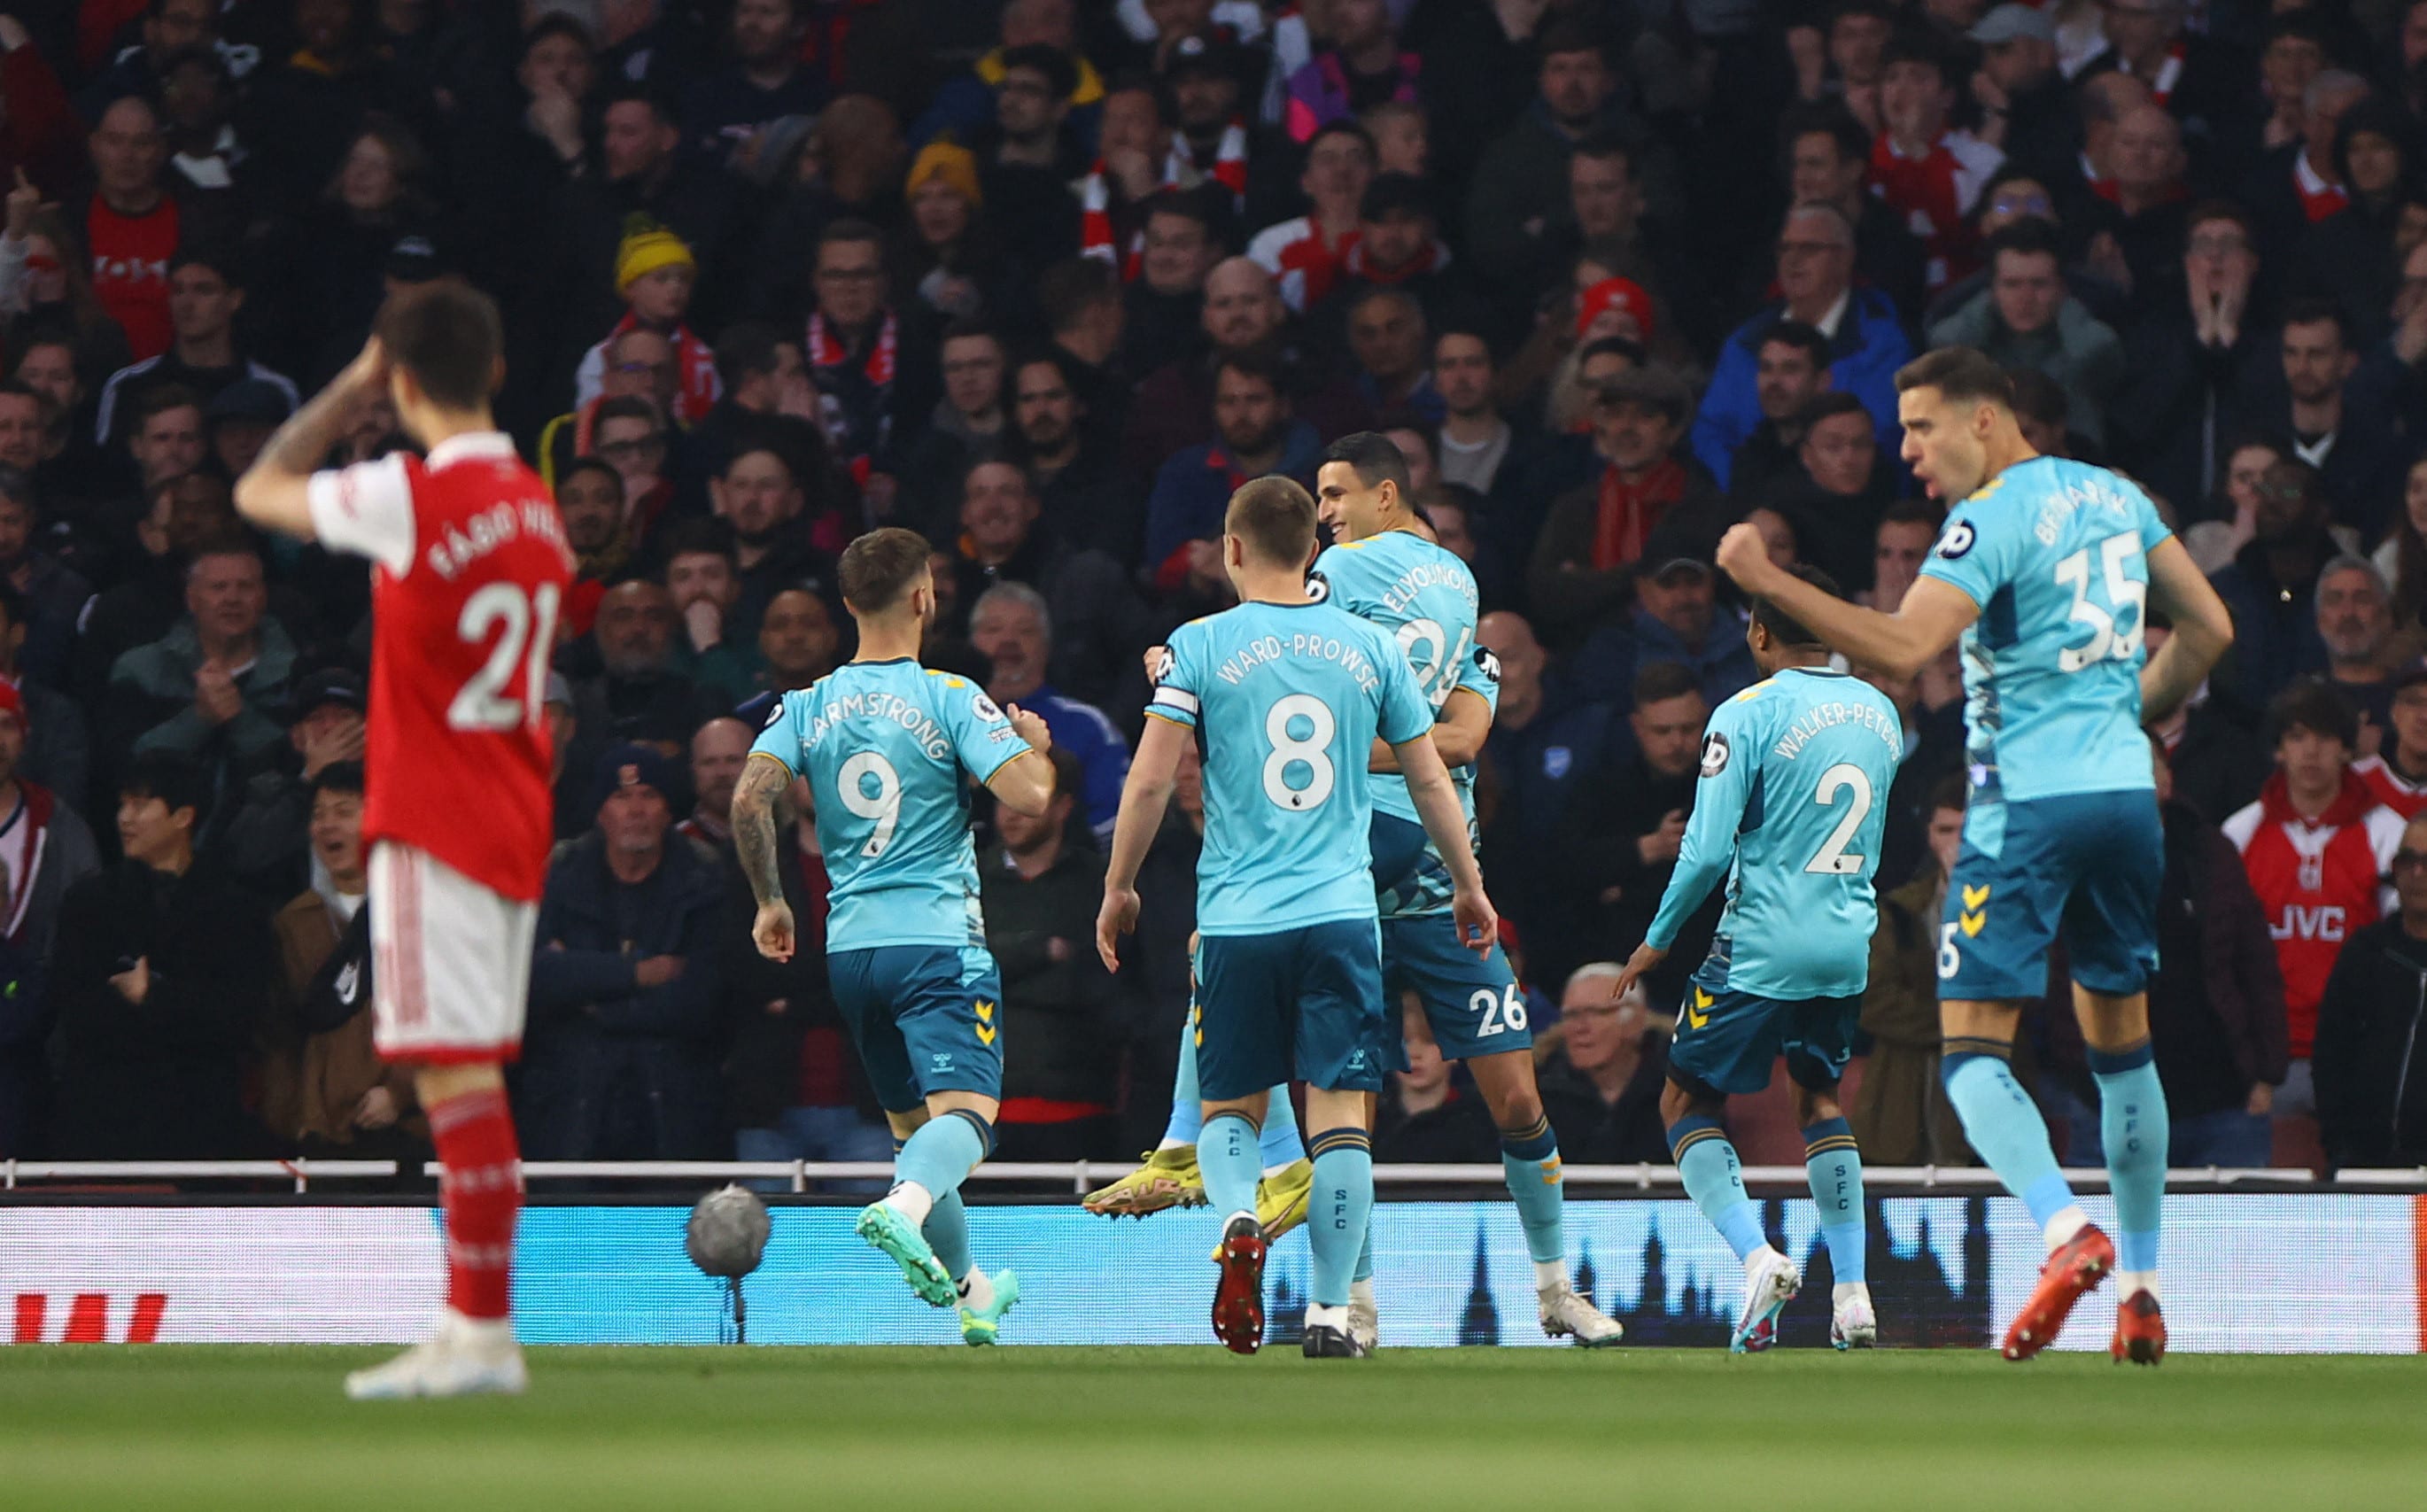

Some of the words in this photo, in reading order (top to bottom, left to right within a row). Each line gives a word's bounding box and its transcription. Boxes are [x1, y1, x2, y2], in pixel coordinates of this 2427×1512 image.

[2055, 530, 2147, 673] 35
[446, 581, 560, 733] 21
[1216, 633, 1379, 694] WARD-PROWSE
[1262, 694, 1336, 811] 8
[1774, 702, 1900, 760] WALKER-PETERS
[838, 752, 901, 857] 9
[1804, 764, 1872, 873] 2
[1936, 922, 1960, 978] 5
[2268, 904, 2346, 942] JVC
[1469, 983, 1527, 1037] 26
[1335, 1189, 1347, 1229] SFC
[1835, 1165, 1849, 1210] SFC
